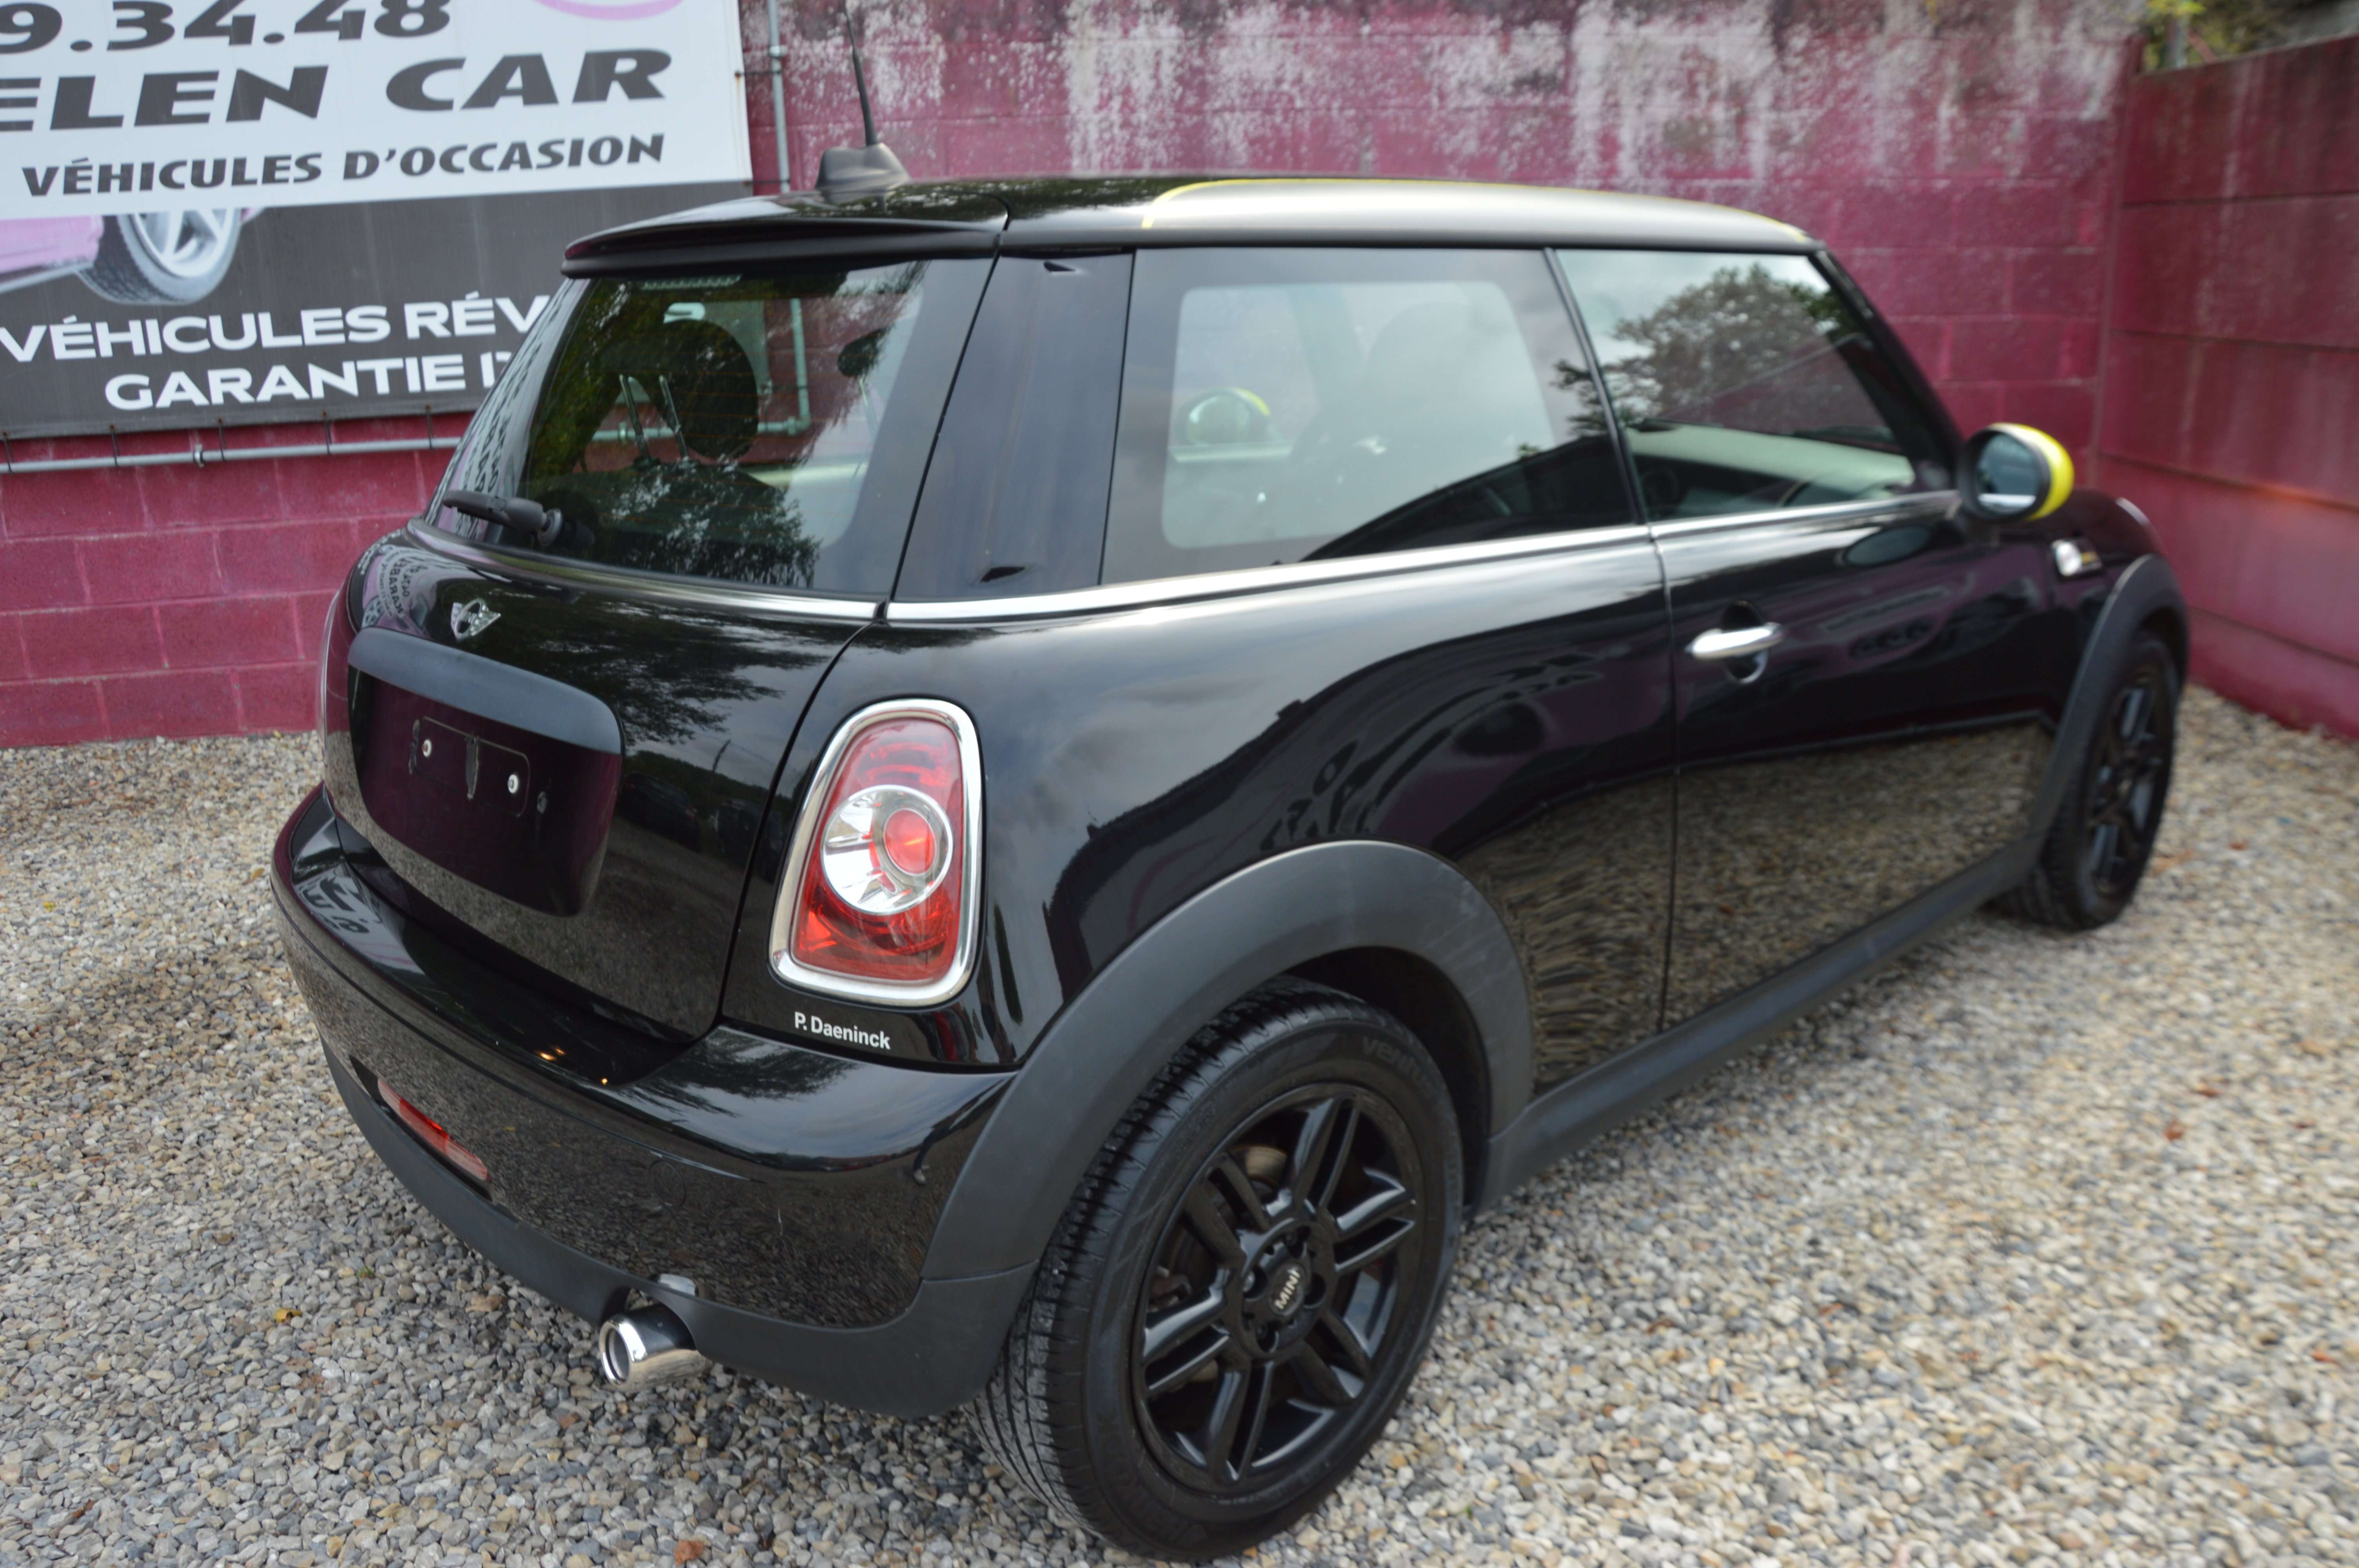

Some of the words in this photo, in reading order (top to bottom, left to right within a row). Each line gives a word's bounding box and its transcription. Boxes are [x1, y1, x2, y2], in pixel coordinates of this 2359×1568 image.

[385, 49, 672, 112] CAR
[22, 153, 322, 197] VÉHICULES
[0, 305, 391, 362] VÉHICULES
[403, 290, 550, 339] RÉV
[105, 354, 466, 410] GARANTIE
[794, 1011, 807, 1031] P.
[811, 1015, 891, 1050] Daeninck
[1274, 1267, 1301, 1310] MINI
